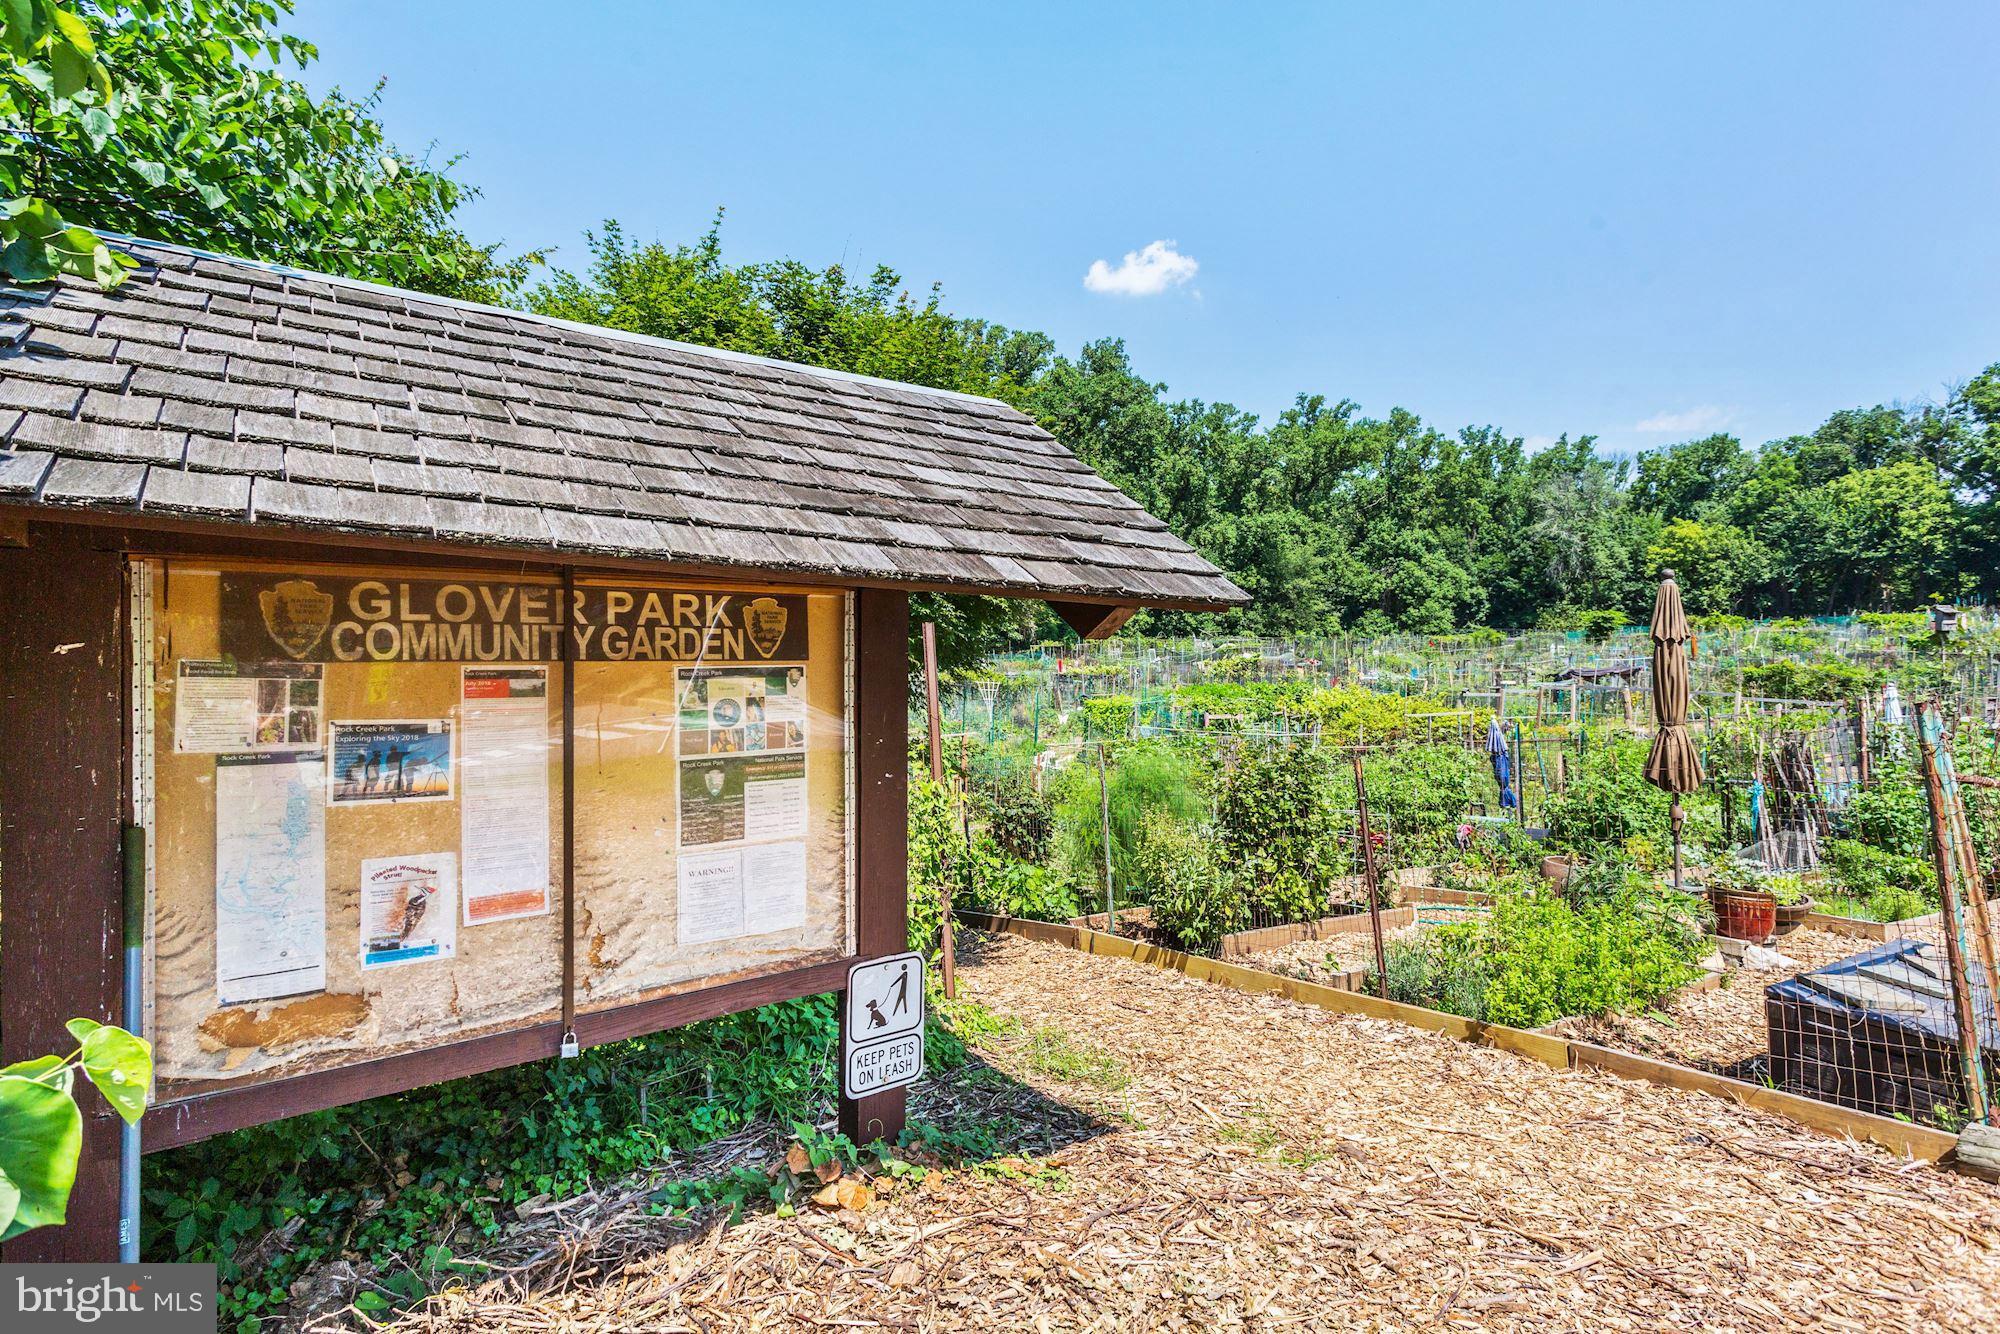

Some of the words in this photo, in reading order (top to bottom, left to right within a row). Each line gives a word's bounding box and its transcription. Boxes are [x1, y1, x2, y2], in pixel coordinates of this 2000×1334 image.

[350, 581, 589, 625] GLOVER
[606, 591, 733, 627] PARK
[331, 621, 596, 660] COMMUNITY
[602, 625, 744, 660] GARDEN
[335, 735, 372, 744] Exploring
[387, 735, 400, 743] Sky
[370, 866, 398, 881] Pileated
[398, 865, 437, 874] Woodpecker
[856, 1049, 885, 1069] KEEP
[889, 1042, 914, 1060] PETS
[858, 1070, 874, 1085] ON
[879, 1058, 912, 1080] LEASH
